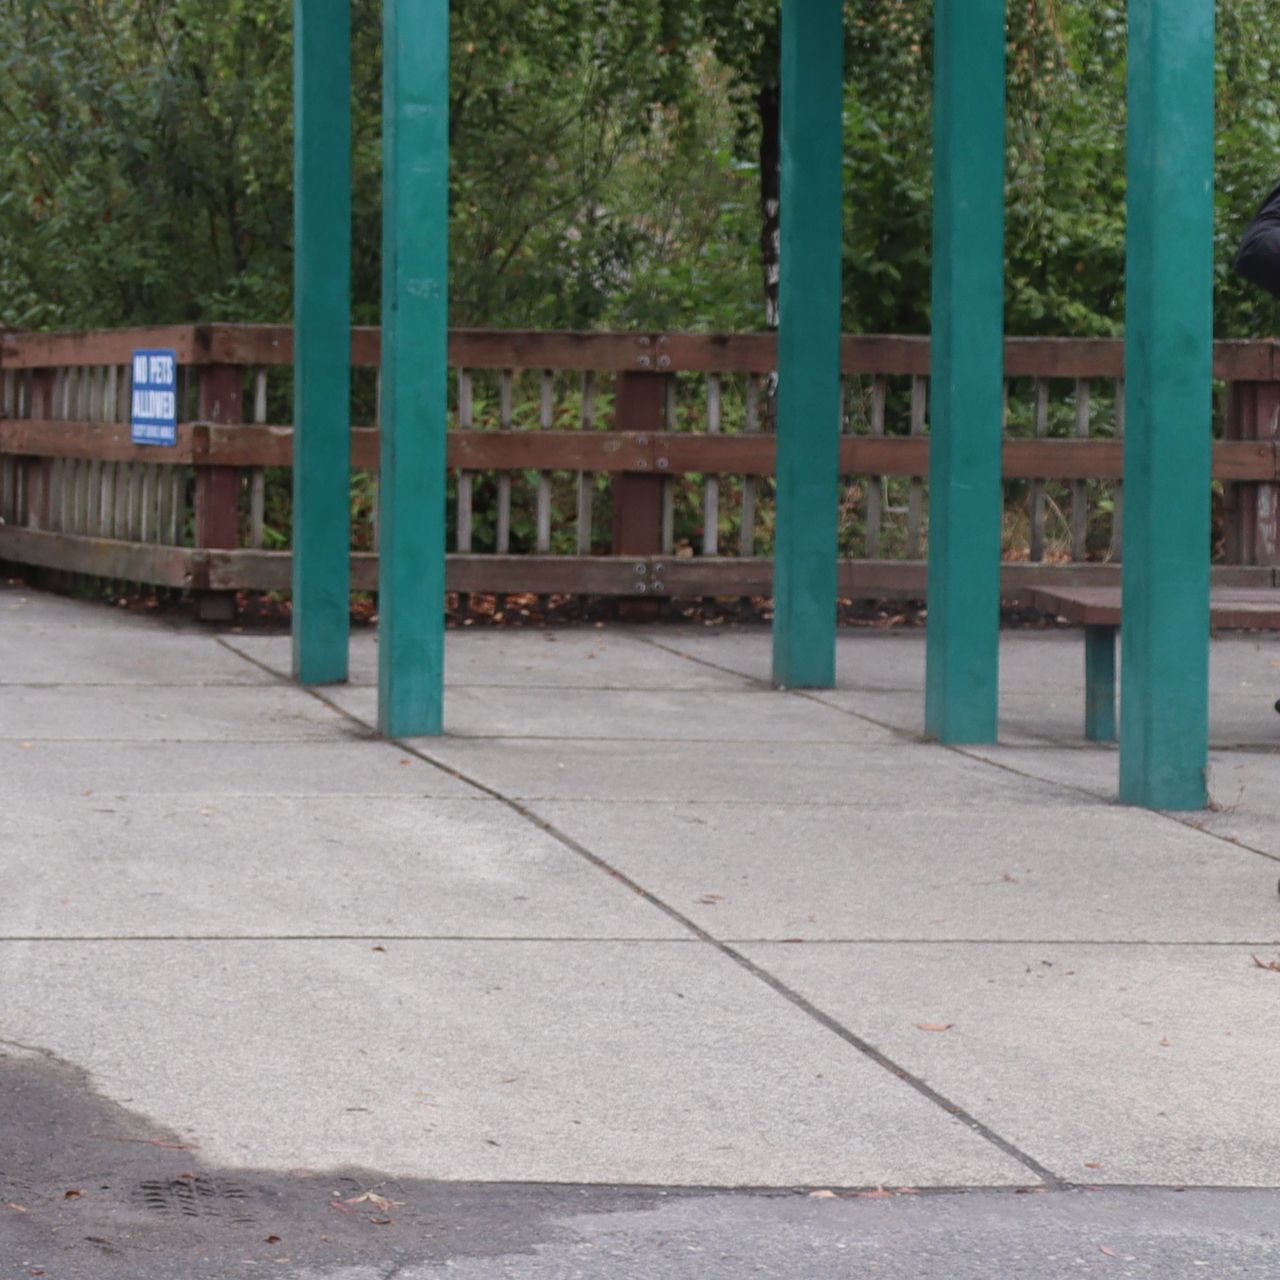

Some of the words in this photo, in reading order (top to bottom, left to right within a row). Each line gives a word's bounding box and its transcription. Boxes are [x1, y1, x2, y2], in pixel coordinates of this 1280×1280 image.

[135, 356, 148, 384] NO
[149, 356, 173, 385] PETS
[133, 390, 175, 419] ALLOWED
